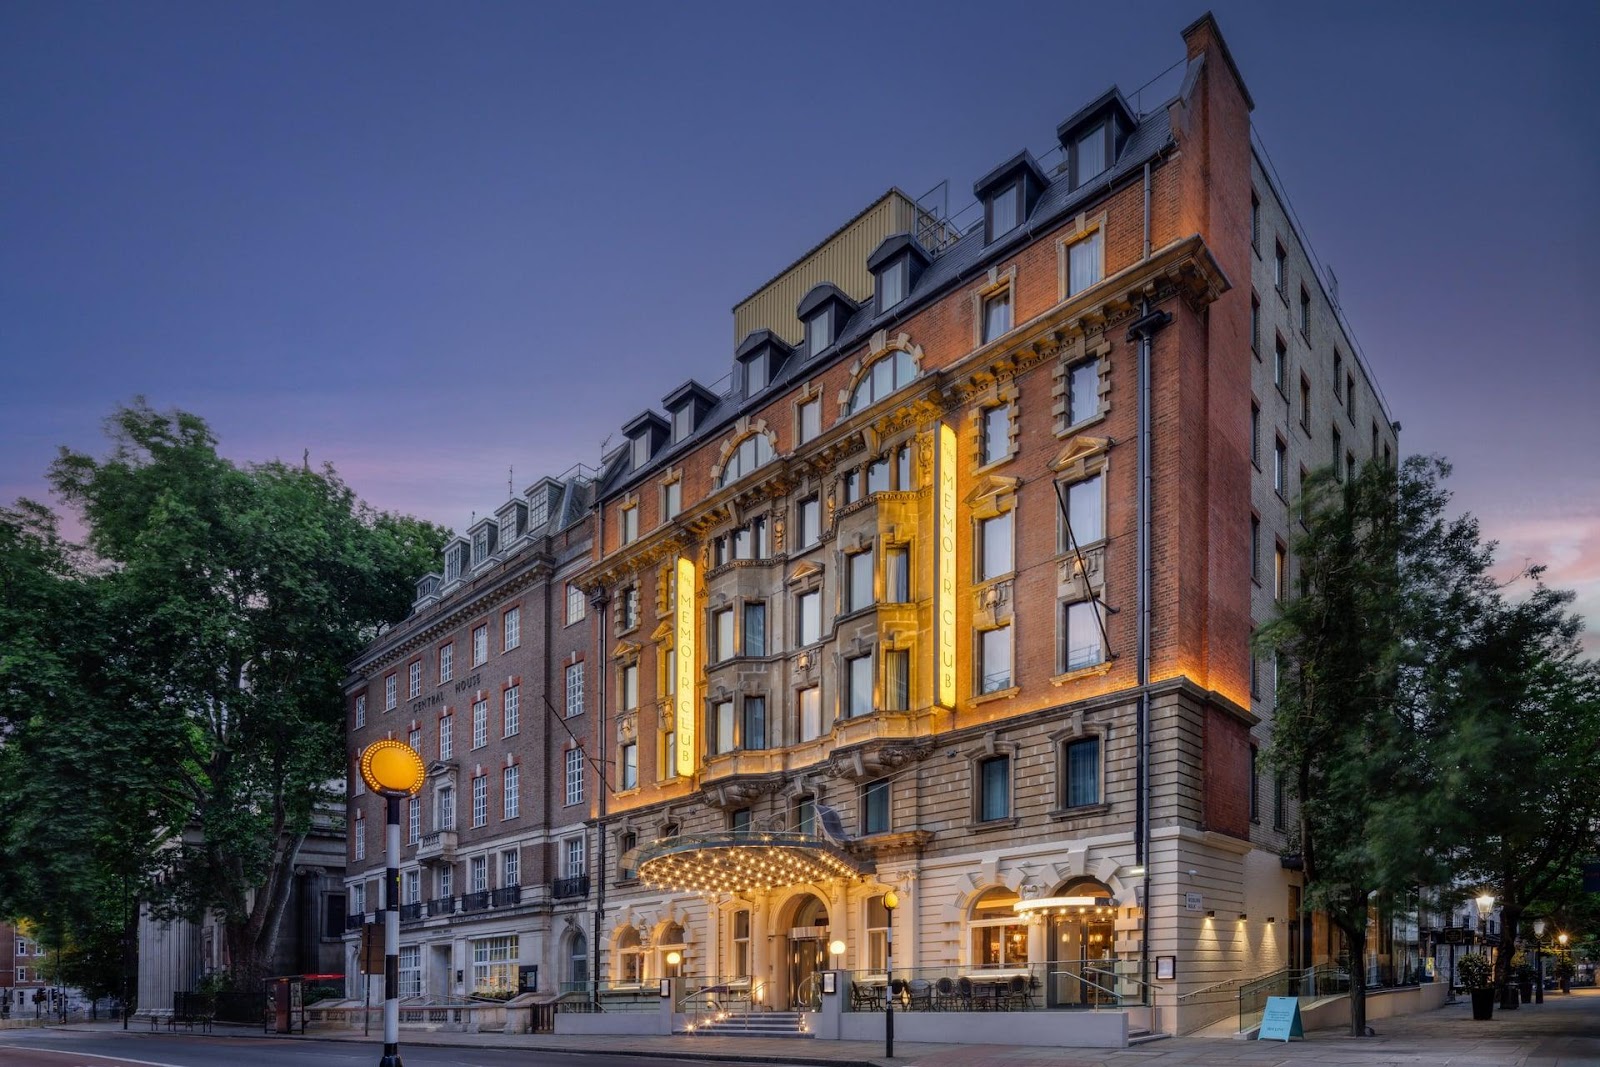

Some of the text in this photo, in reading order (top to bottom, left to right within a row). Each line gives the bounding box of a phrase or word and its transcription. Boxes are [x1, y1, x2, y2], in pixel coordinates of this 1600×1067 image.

[943, 471, 953, 593] MEMOIR
[681, 594, 692, 690] MEMOIR
[943, 609, 953, 688] CLUB
[413, 673, 480, 713] CENTRAL HOUSE
[681, 701, 691, 762] CLUB
